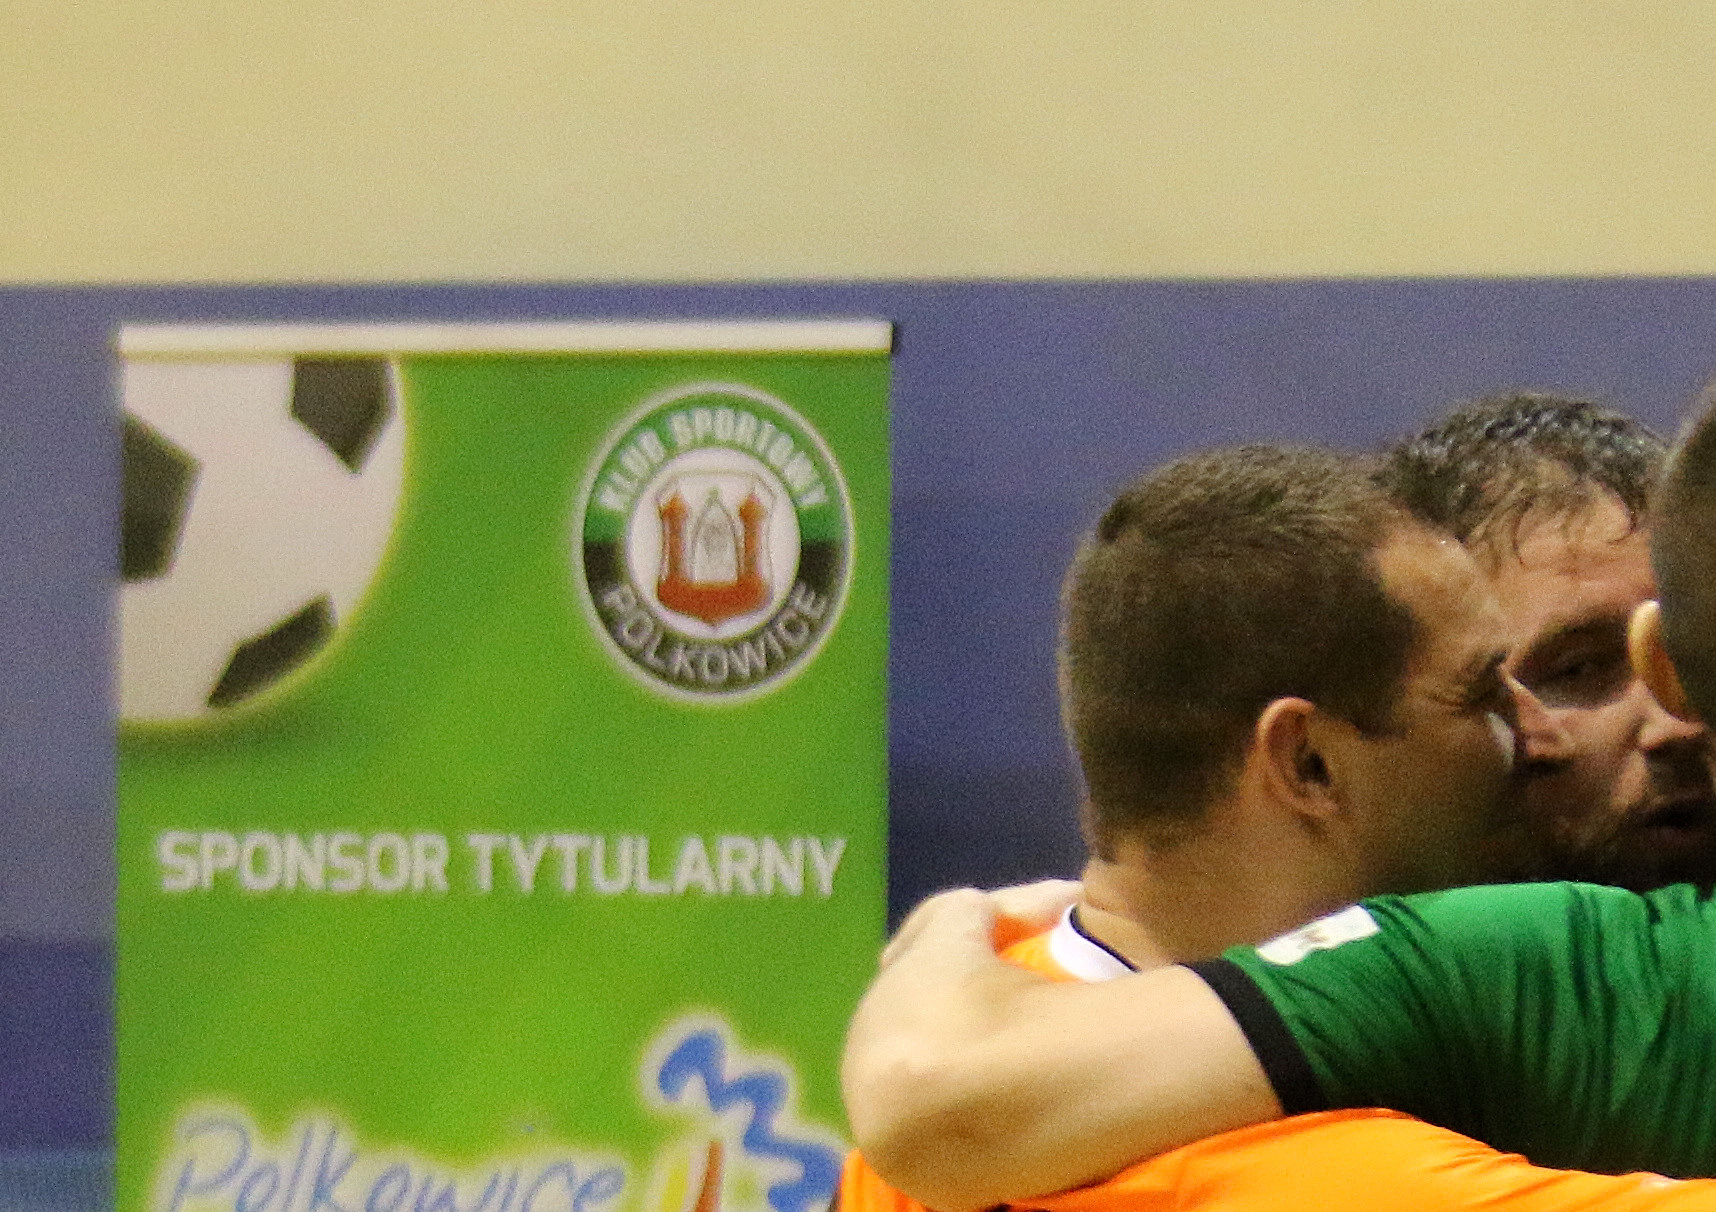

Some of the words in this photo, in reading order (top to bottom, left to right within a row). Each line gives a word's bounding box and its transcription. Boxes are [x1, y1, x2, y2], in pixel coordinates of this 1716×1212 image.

[599, 429, 666, 511] KLUB
[668, 407, 828, 507] SPORTOWY
[603, 581, 827, 683] POLKOWICE
[156, 828, 450, 894] SPONSOR
[468, 831, 848, 899] TYTULARNY
